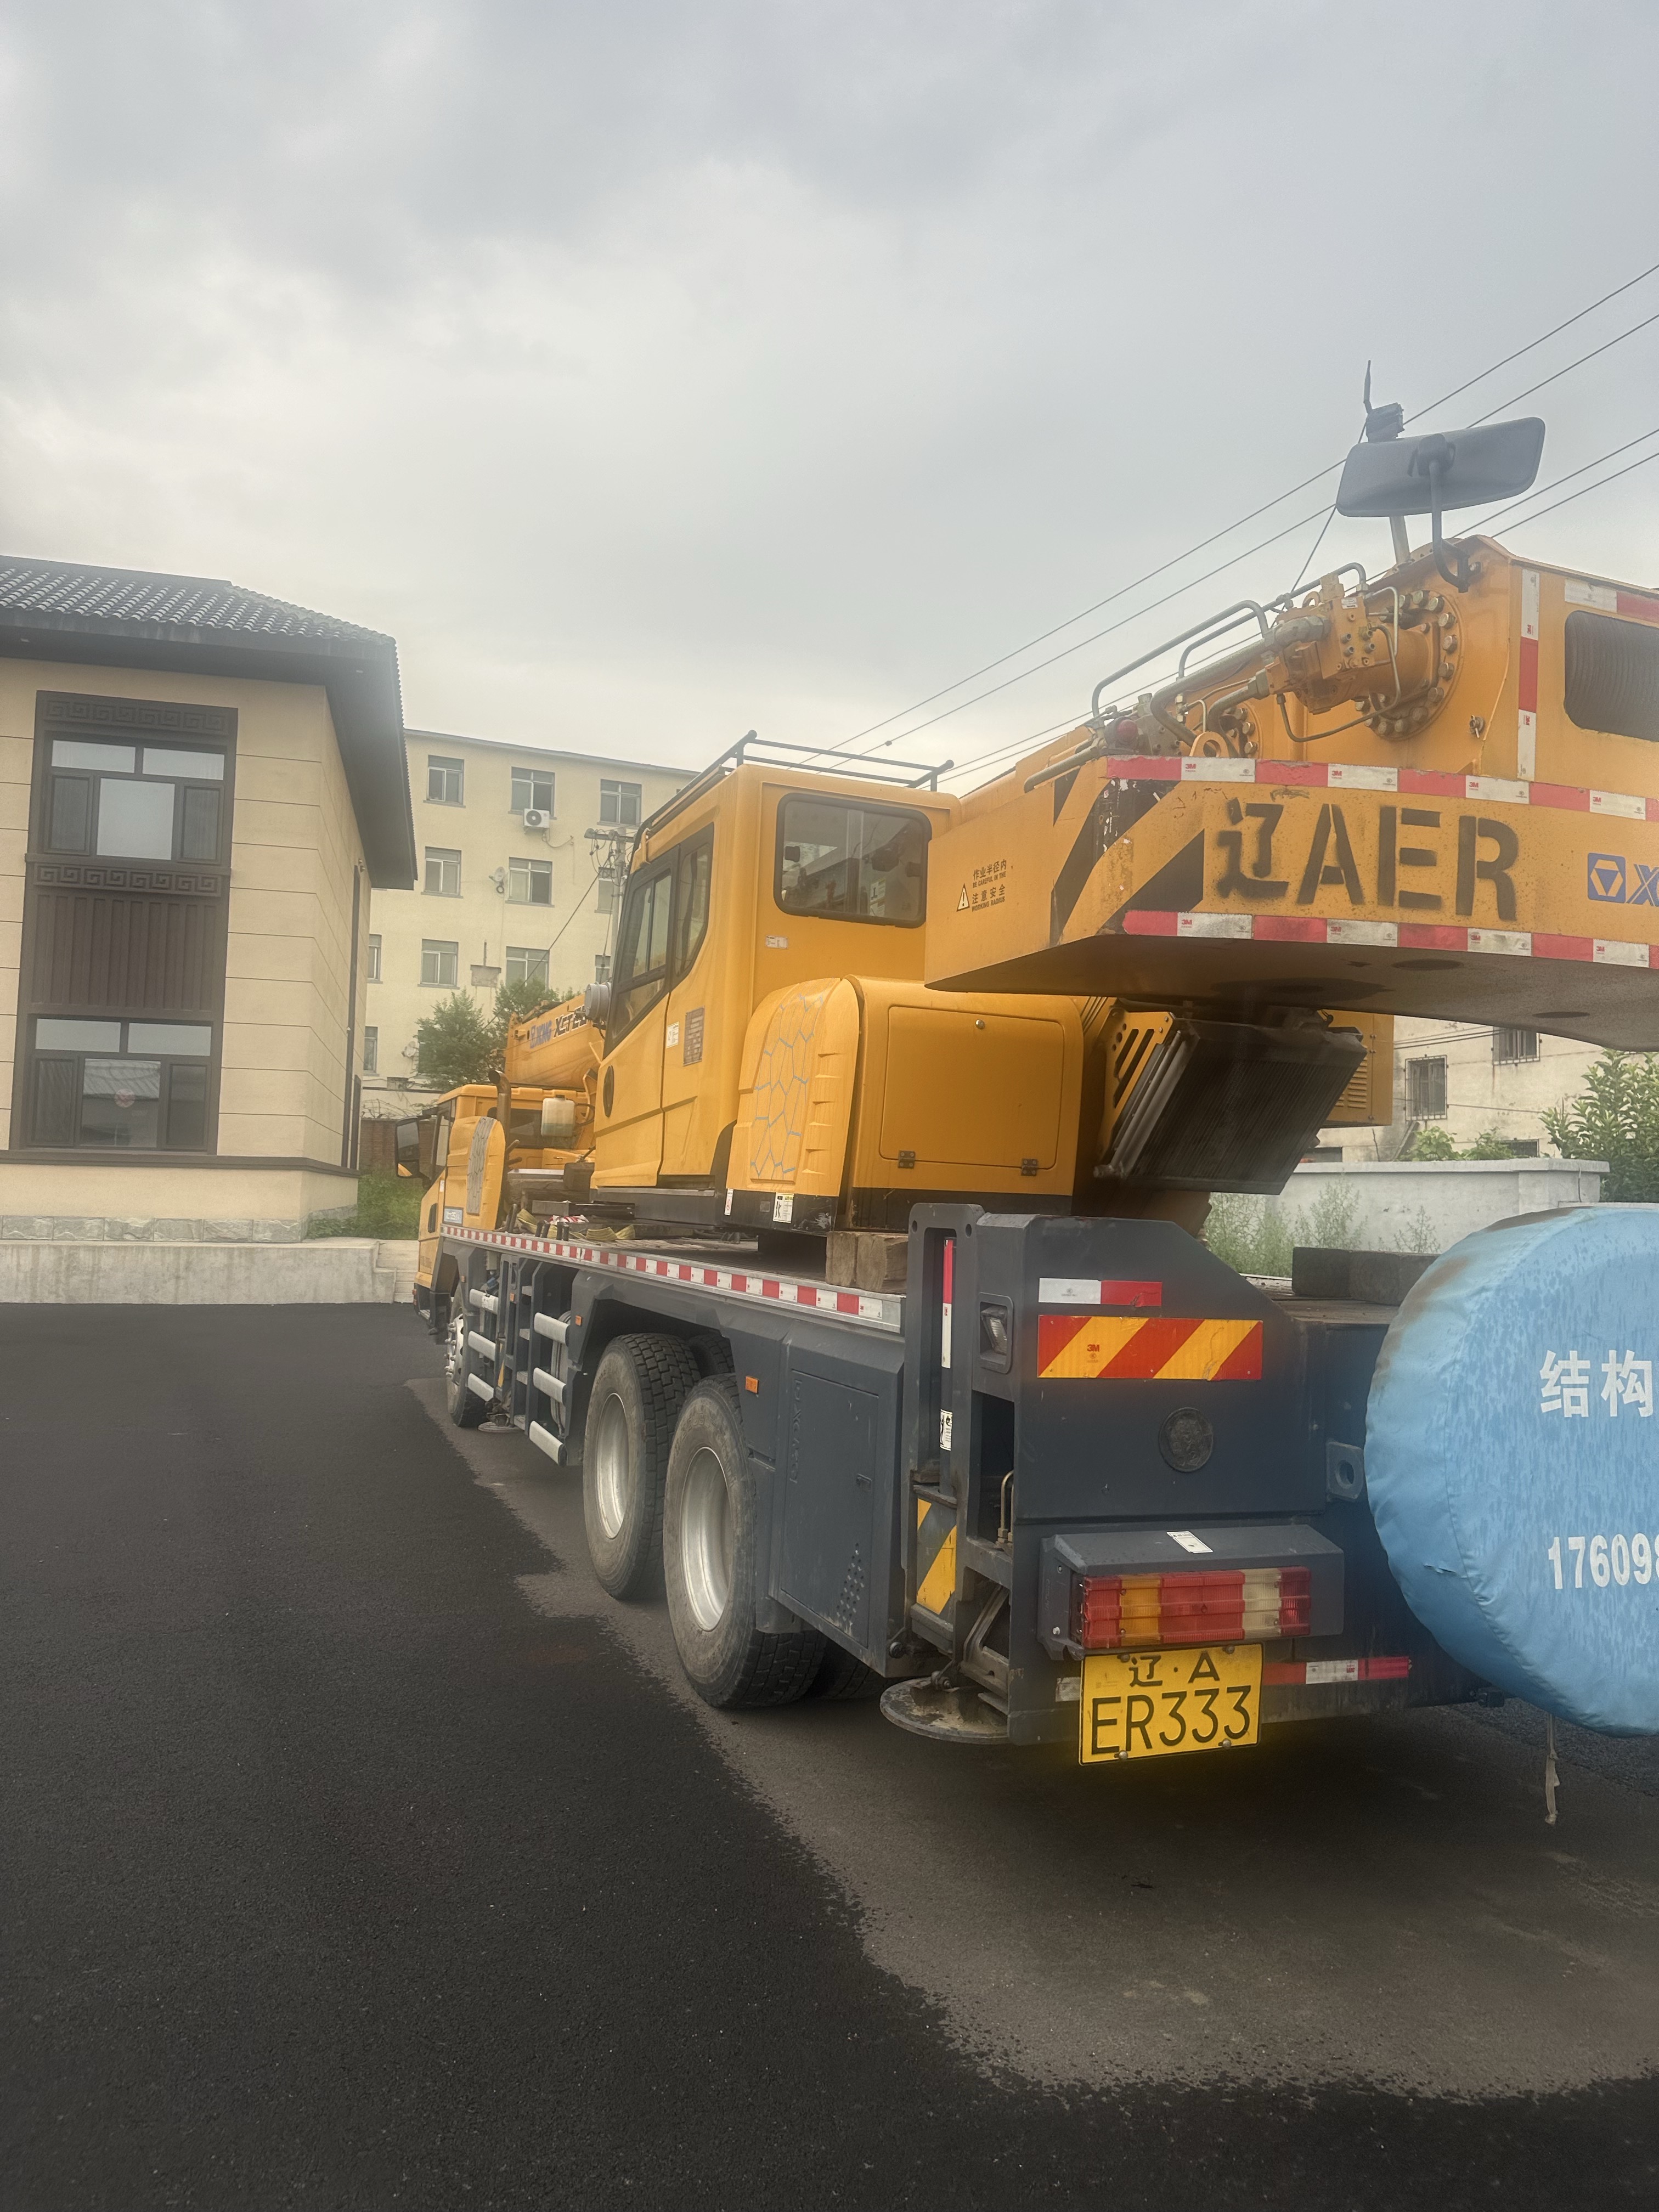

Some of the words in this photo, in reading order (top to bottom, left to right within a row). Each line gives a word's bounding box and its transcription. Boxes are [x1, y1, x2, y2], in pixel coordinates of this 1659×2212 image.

[1217, 797, 1519, 921] 辽AER
[972, 883, 1006, 905] 注意安全
[978, 876, 993, 887] CAREFUL
[990, 896, 1006, 906] RADIUS
[1626, 864, 1659, 907] X
[1087, 1344, 1100, 1352] 3M
[1539, 1350, 1654, 1418] 结构
[1548, 1532, 1659, 1590] 17609
[1092, 1685, 1251, 1754] ER333
